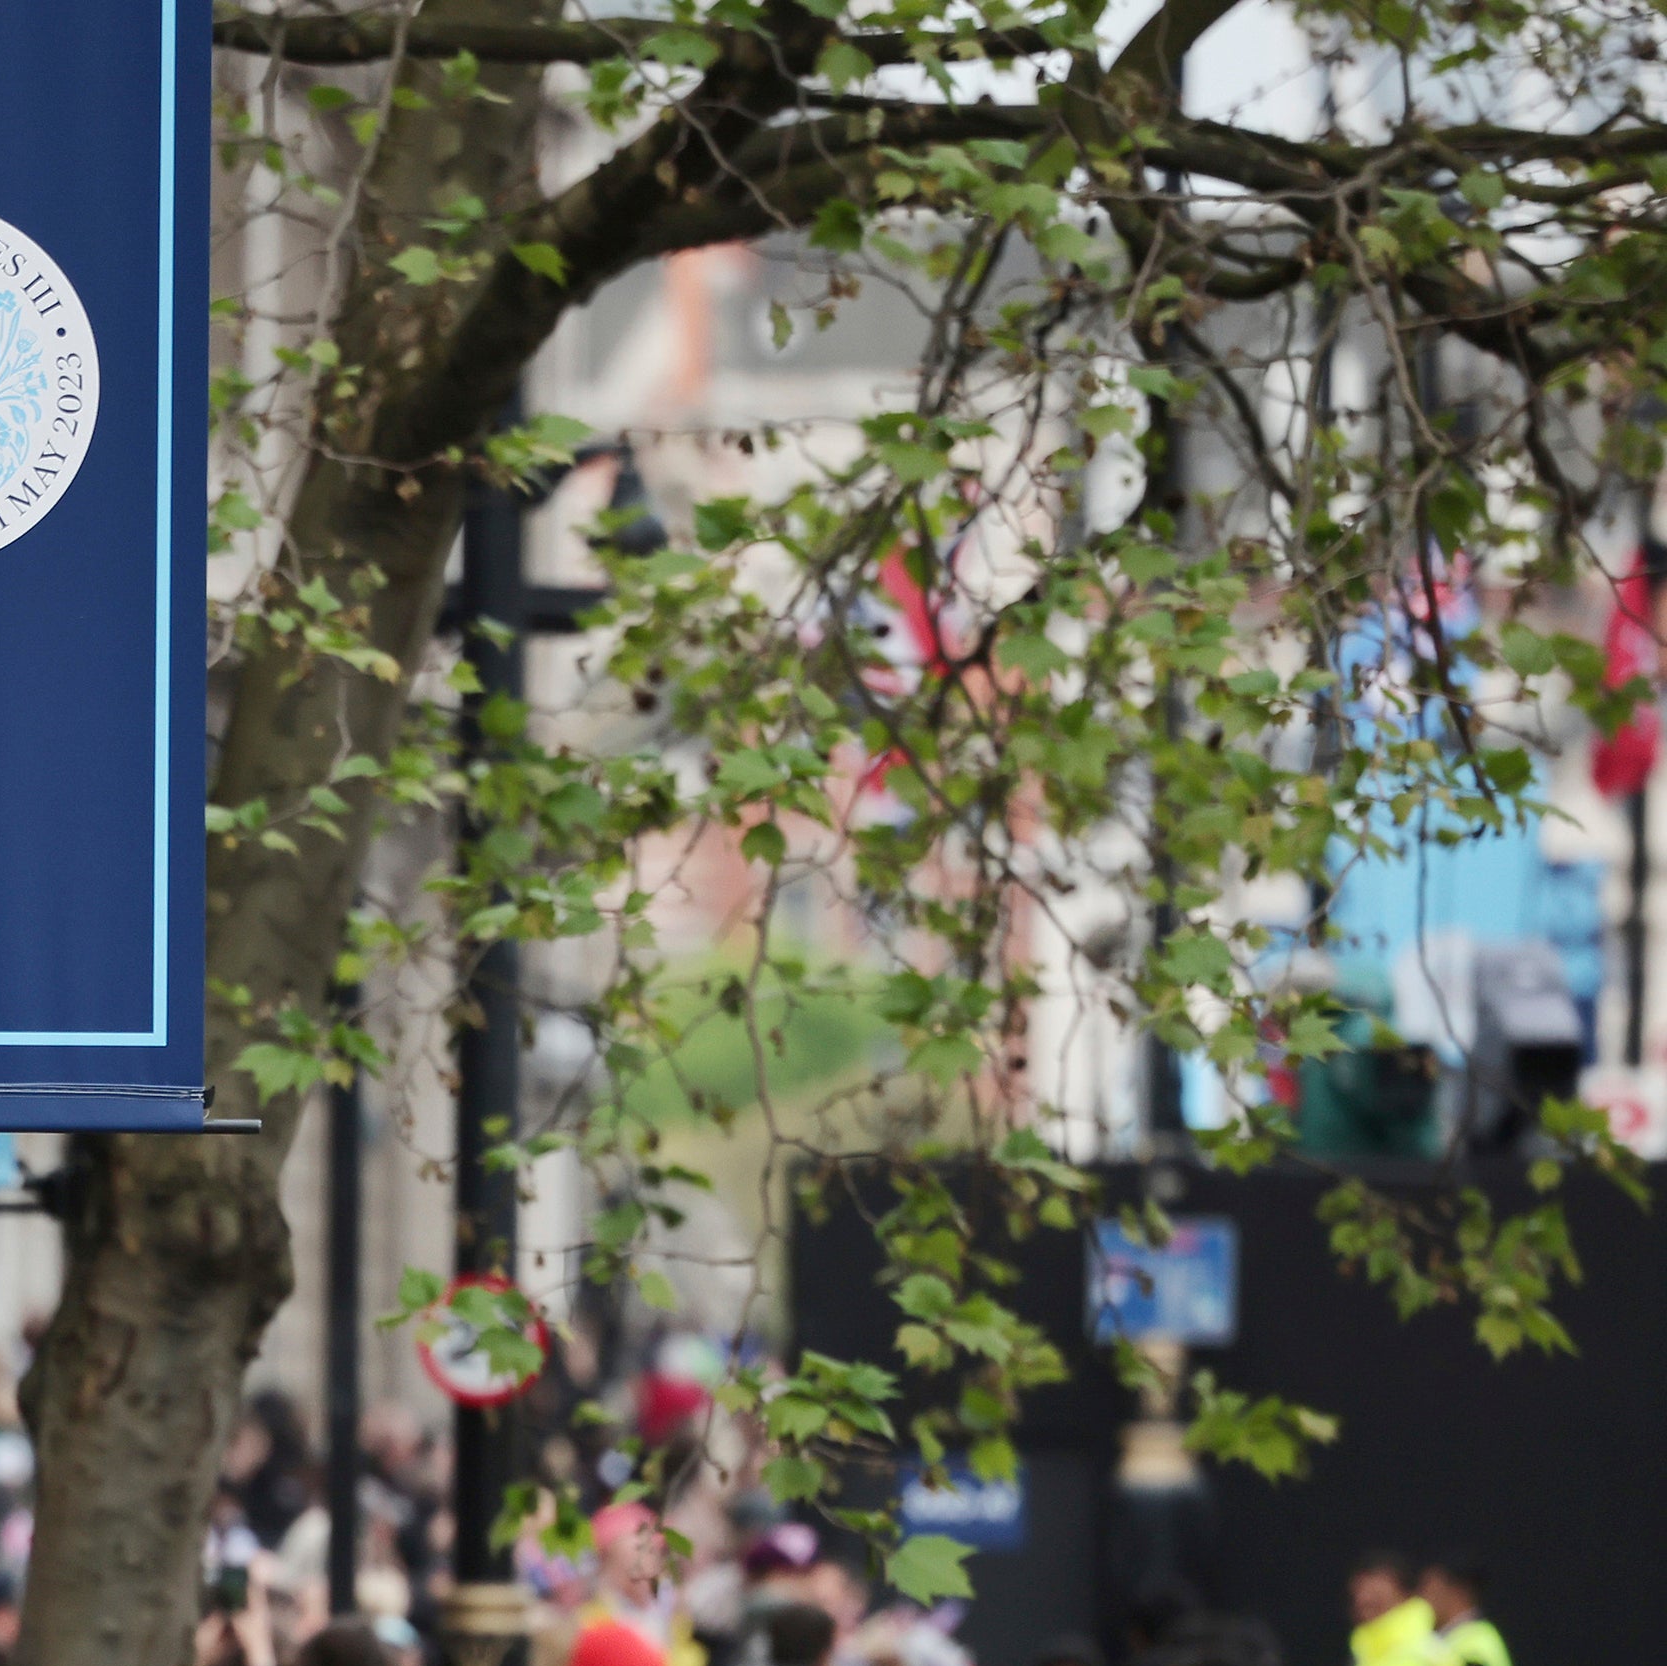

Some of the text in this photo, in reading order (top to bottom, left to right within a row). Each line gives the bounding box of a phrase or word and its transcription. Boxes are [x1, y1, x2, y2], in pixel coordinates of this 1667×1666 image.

[19, 271, 65, 318] III
[6, 440, 69, 518] MAY
[53, 352, 83, 437] 2023
